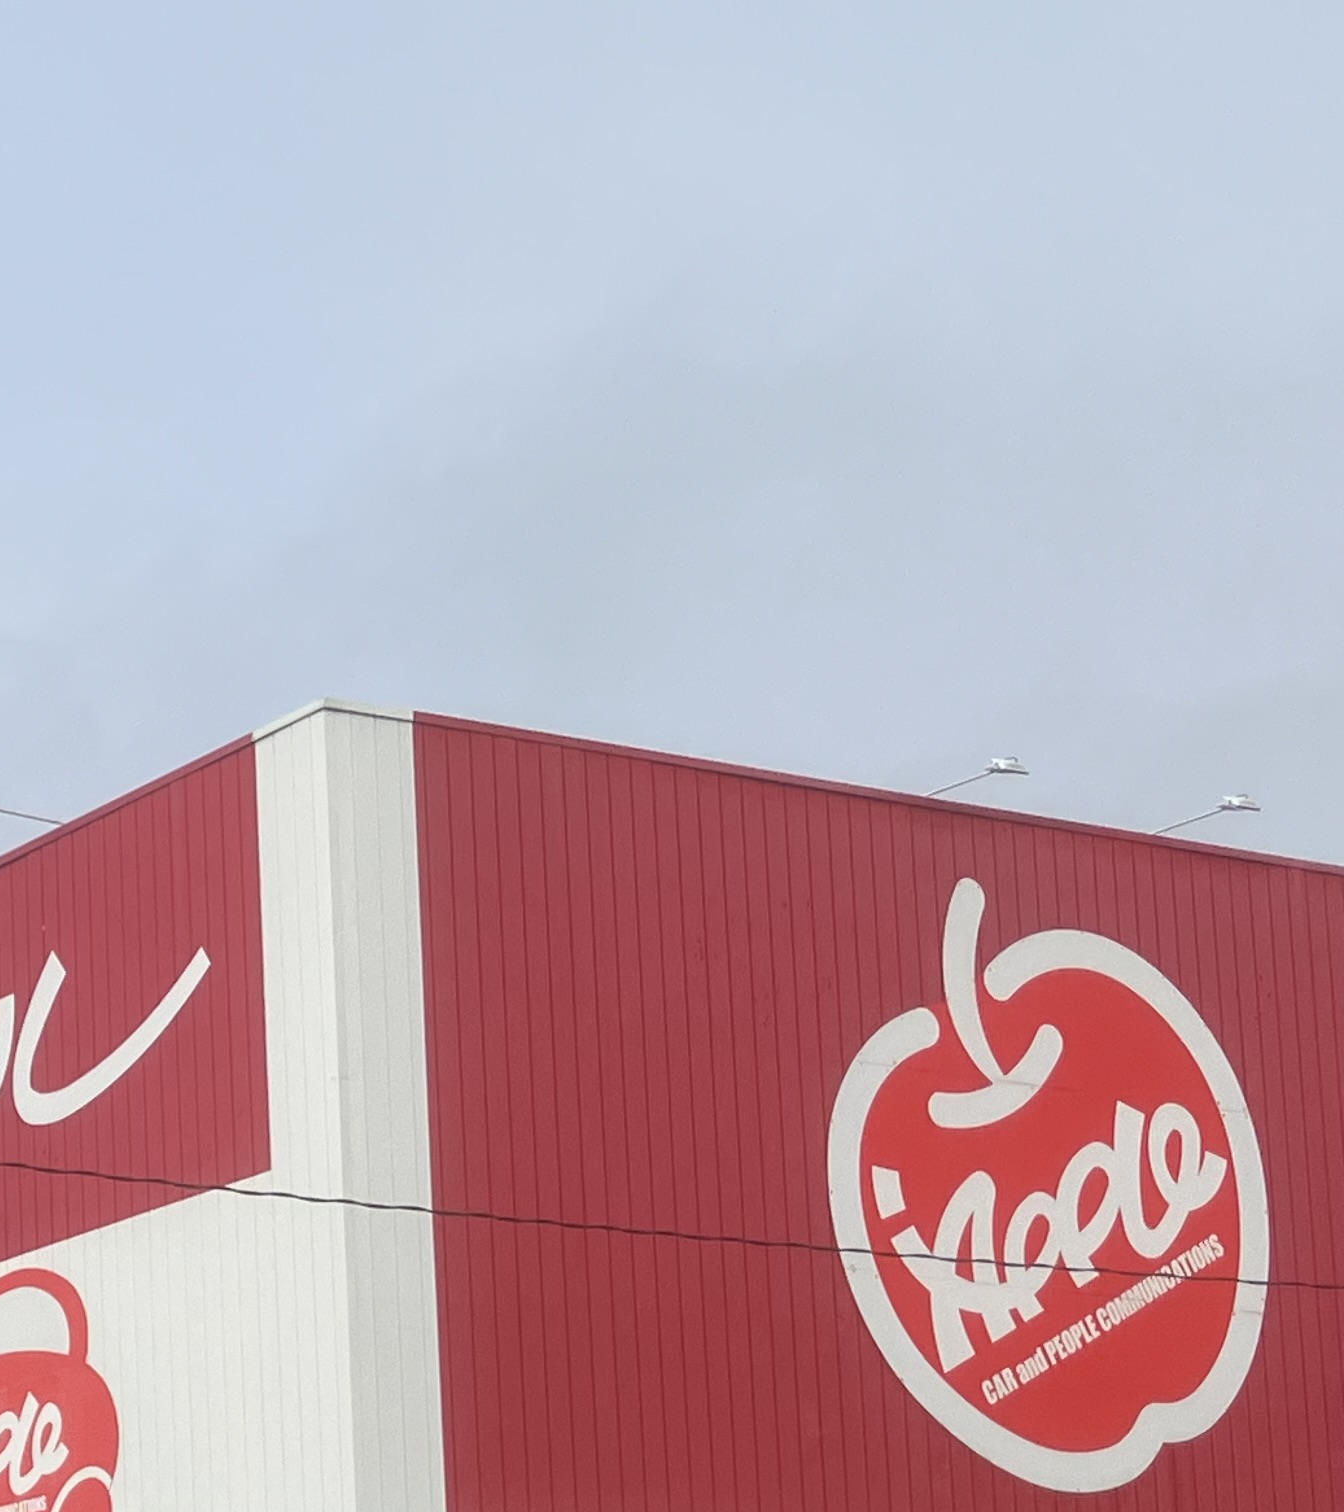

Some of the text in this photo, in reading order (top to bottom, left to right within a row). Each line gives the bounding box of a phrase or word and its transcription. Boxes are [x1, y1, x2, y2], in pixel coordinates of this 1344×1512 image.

[981, 1234, 1224, 1405] CAR and PEOPLE COMMUNICATIONS
